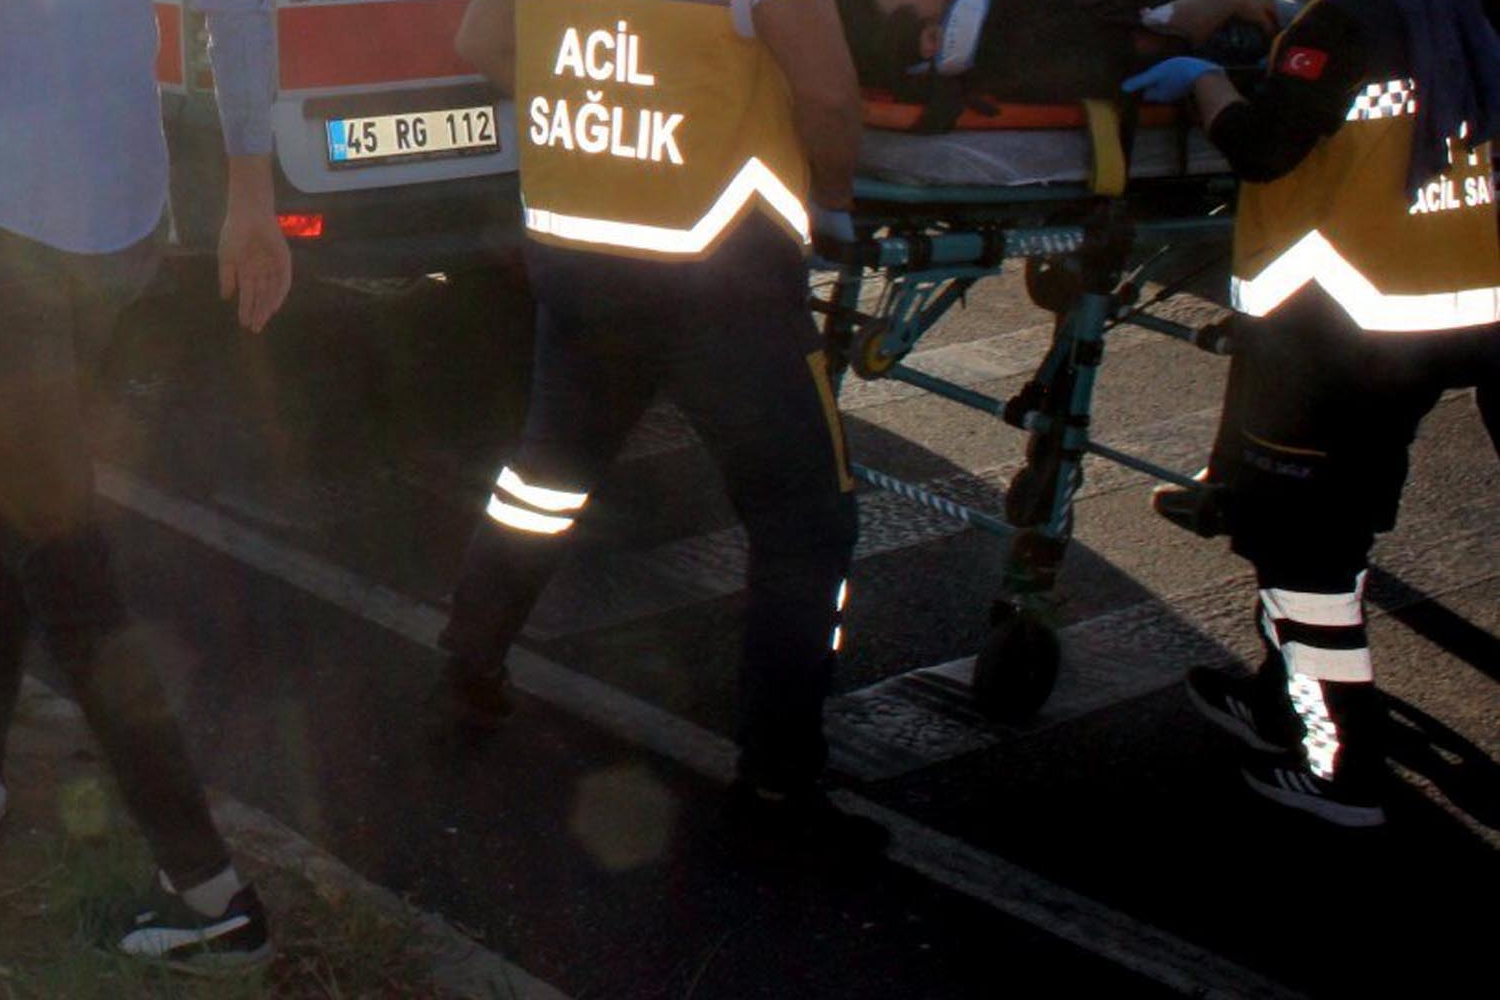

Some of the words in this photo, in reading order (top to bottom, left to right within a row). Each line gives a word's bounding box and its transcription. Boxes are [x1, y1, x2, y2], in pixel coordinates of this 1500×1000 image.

[554, 20, 655, 86] ACİL
[346, 121, 378, 154] 45
[395, 117, 428, 149] RG
[446, 111, 493, 146] 112
[530, 89, 685, 165] SAĞLIK
